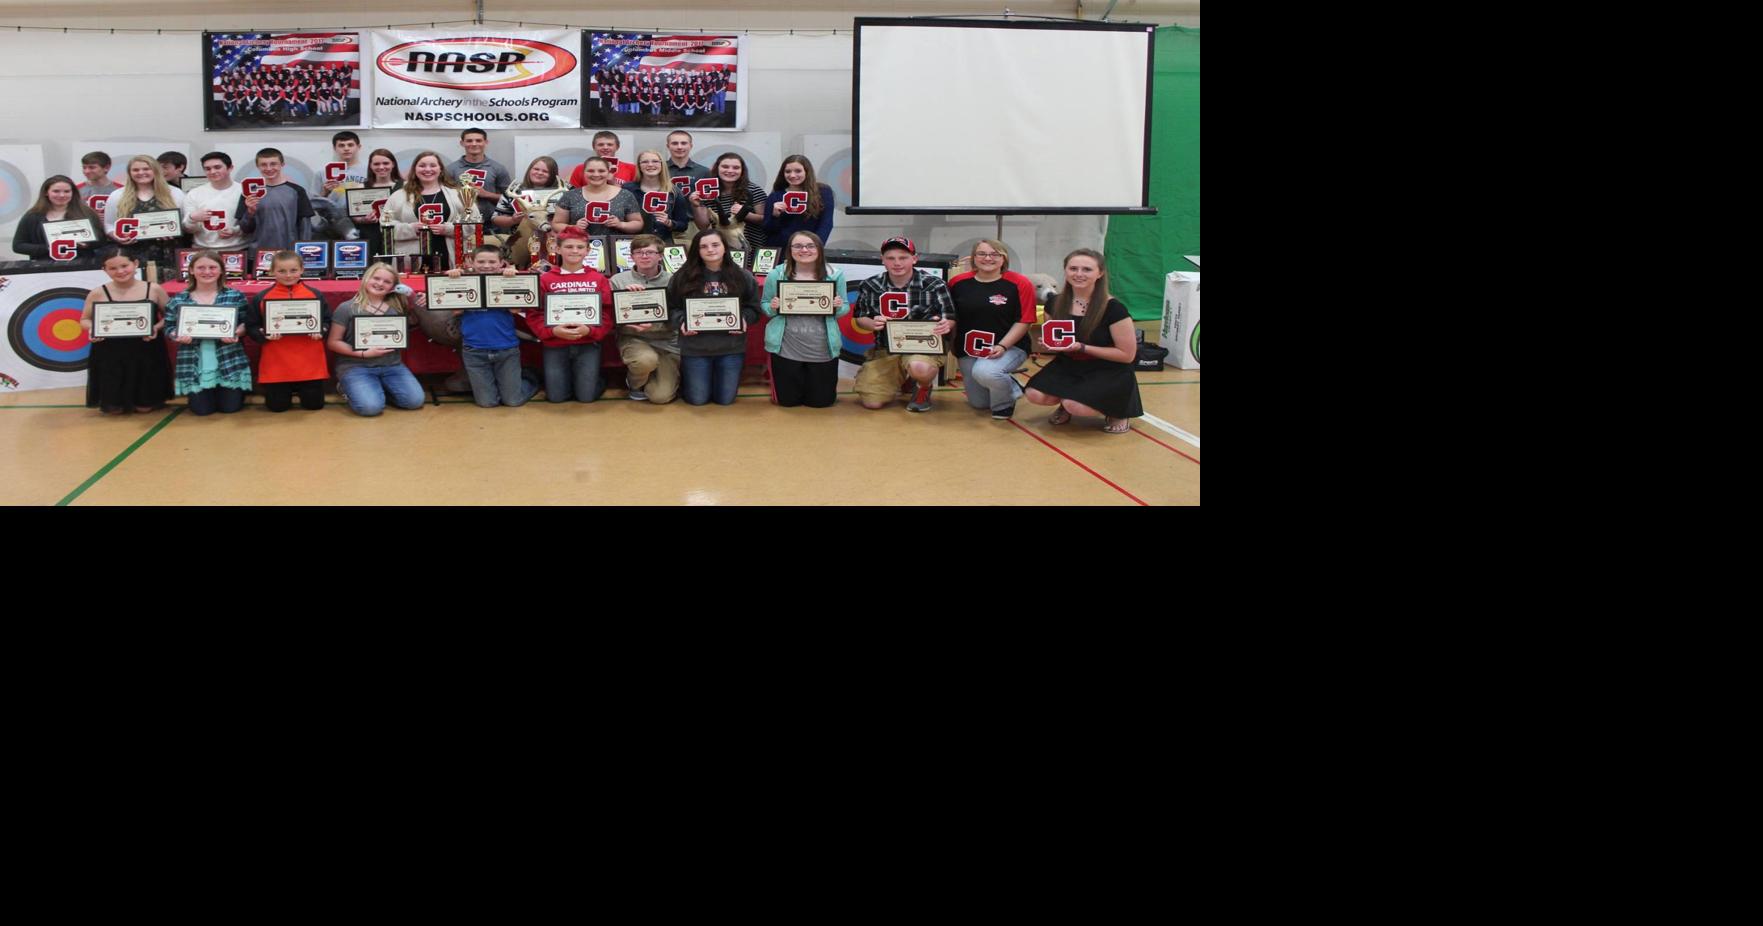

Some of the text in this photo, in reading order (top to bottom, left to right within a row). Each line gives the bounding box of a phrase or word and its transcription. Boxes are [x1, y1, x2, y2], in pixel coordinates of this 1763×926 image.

[407, 51, 526, 73] NASP
[375, 97, 420, 106] National
[421, 97, 463, 108] Archery
[489, 97, 530, 107] Schools
[531, 97, 578, 108] Program
[404, 112, 550, 121] NASPSCHOOLS.ORG
[241, 177, 267, 198] C
[694, 177, 719, 201] C
[585, 201, 611, 224] C
[642, 191, 670, 214] C
[782, 191, 808, 215] C
[114, 218, 139, 240] C
[49, 239, 77, 261] C
[550, 281, 597, 290] CARDINALS
[878, 291, 909, 320] C
[963, 329, 996, 358] C
[1041, 319, 1076, 350] C
